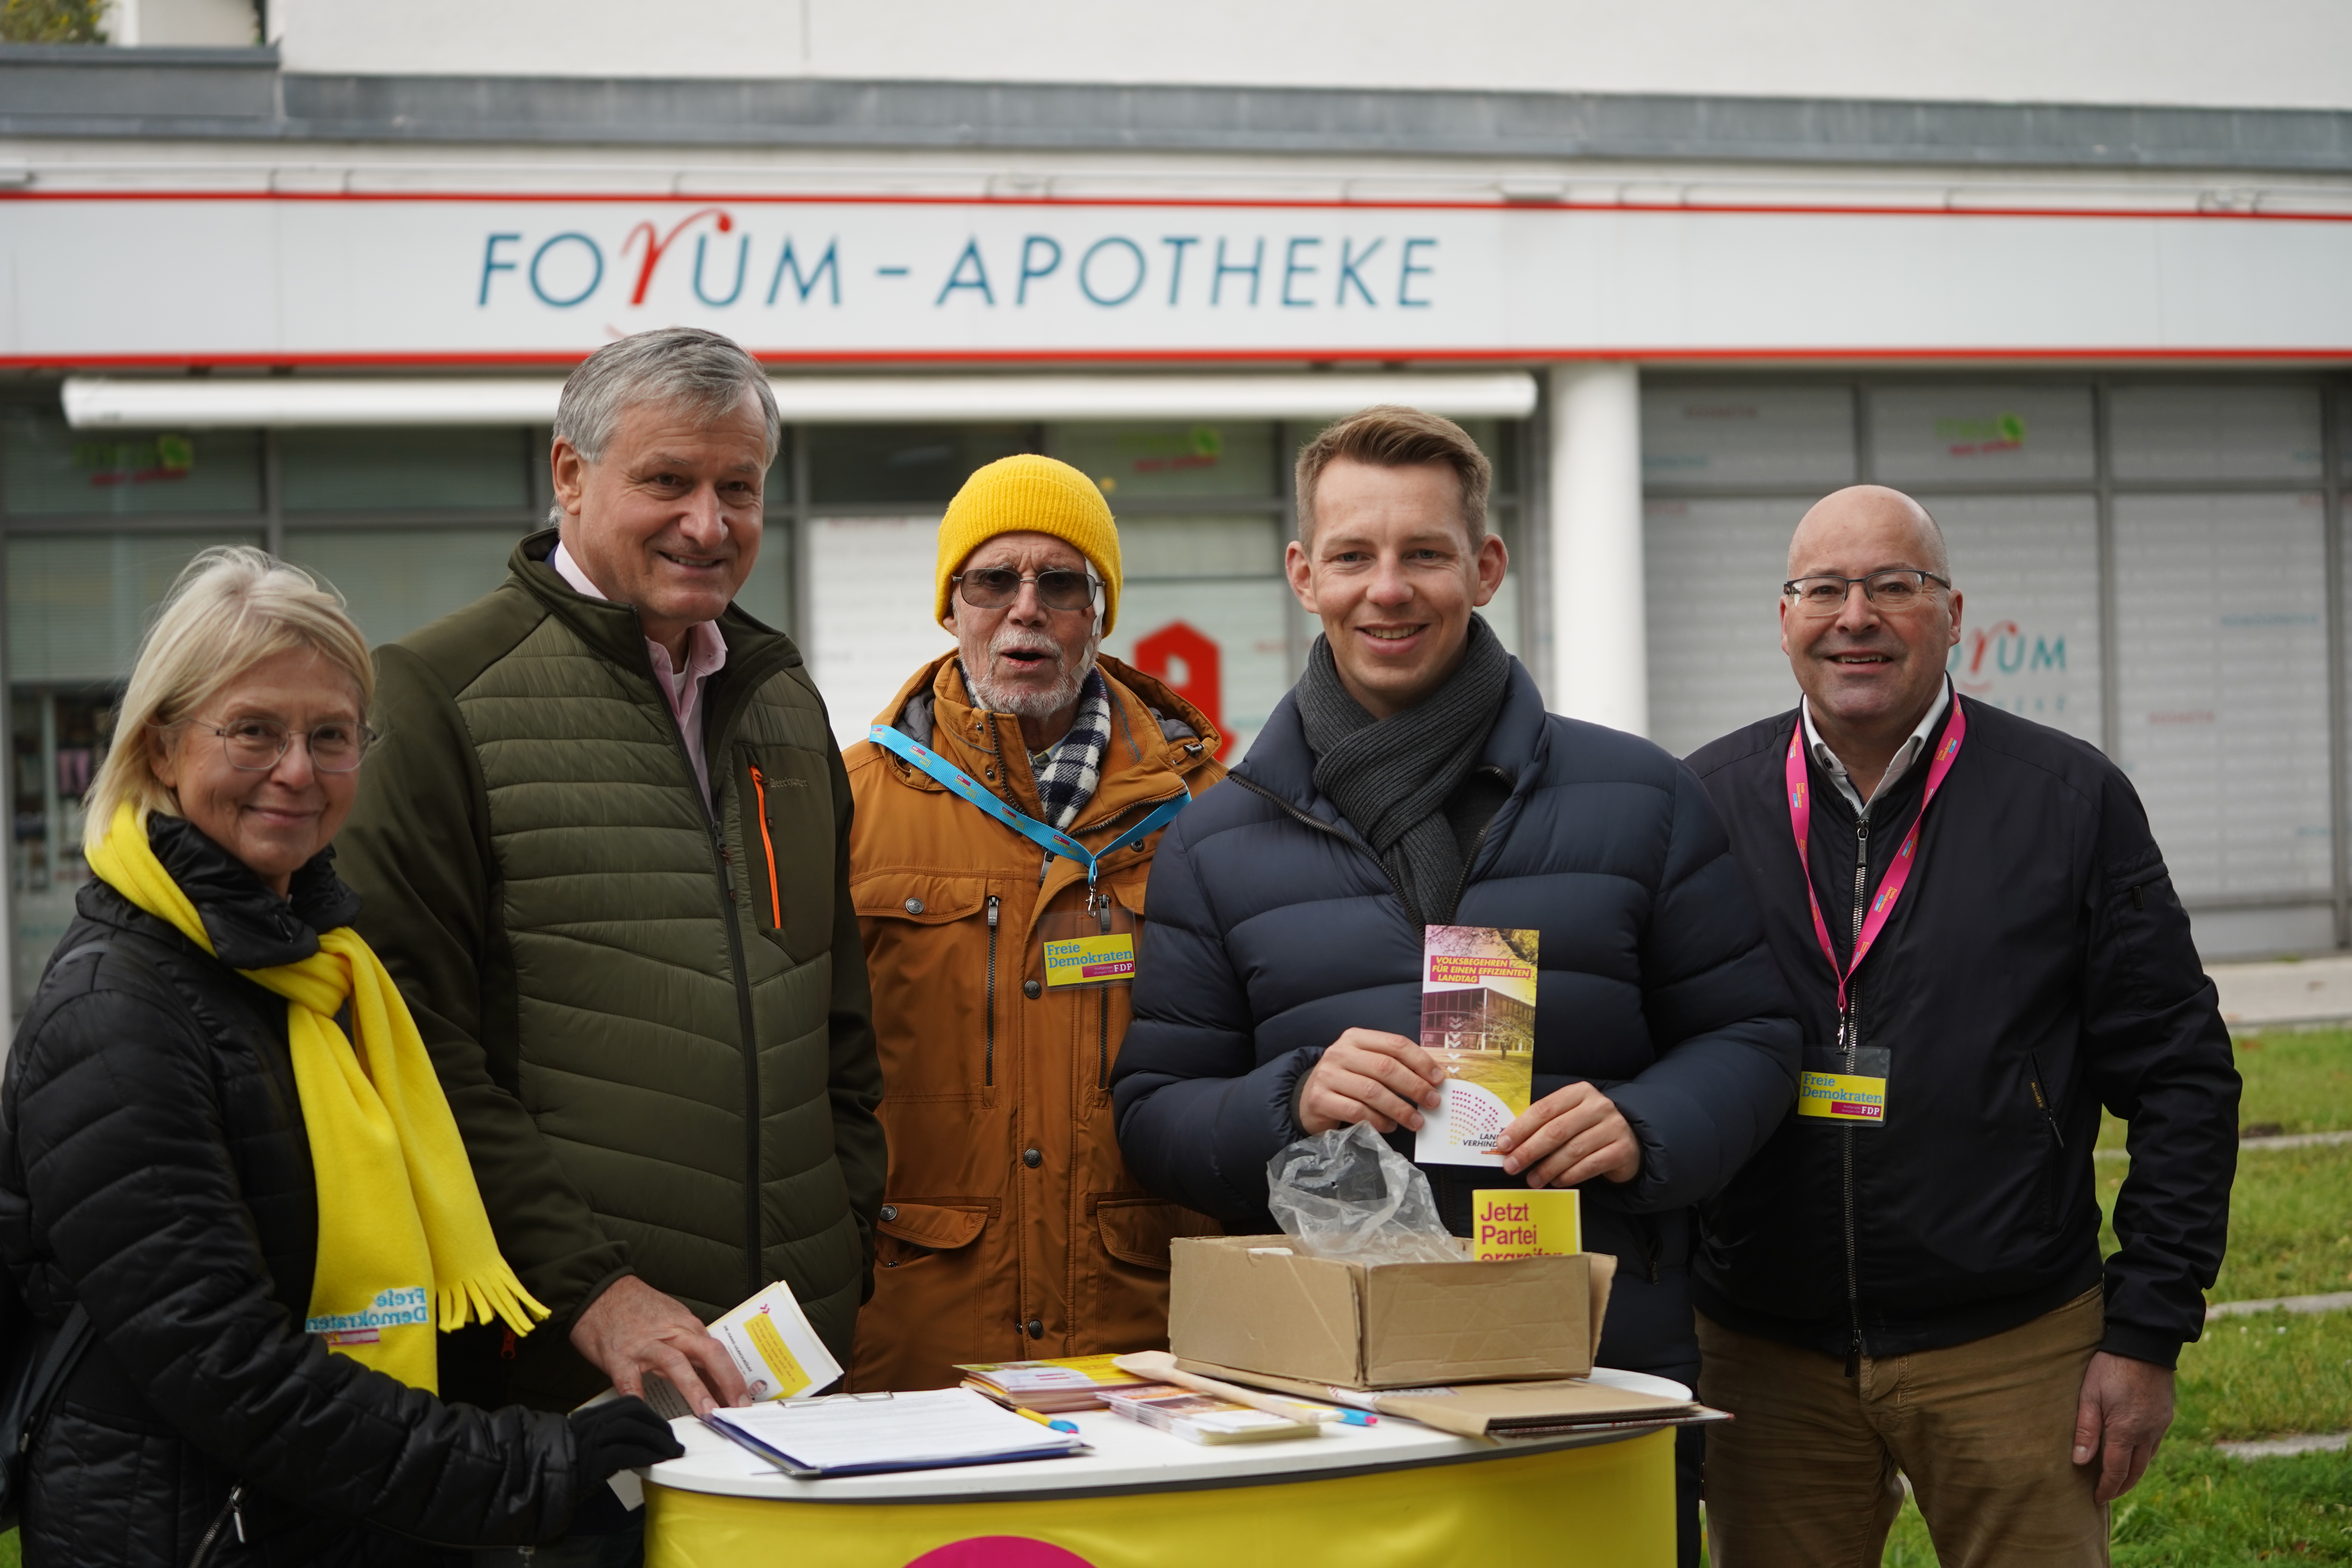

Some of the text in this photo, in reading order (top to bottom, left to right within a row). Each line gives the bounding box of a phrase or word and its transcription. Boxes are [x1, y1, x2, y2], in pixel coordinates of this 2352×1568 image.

[934, 235, 1439, 308] APOTHEKE
[1940, 737, 1954, 760] Demokraten
[1878, 886, 1894, 912] Demokraten
[1889, 888, 1898, 899] Freie
[1046, 942, 1080, 956] Freie
[1048, 950, 1133, 968] Demokraten
[1436, 956, 1508, 967] VOLKSBEGEHREN
[1113, 963, 1132, 972] FDP
[1432, 964, 1448, 973] FÜR
[1478, 967, 1529, 977] EFFIZIENTEN
[1438, 974, 1478, 983] LANDTAG
[1803, 1073, 1835, 1087] Freie
[1802, 1085, 1882, 1103] Demokraten
[1861, 1106, 1880, 1115] FDP
[1481, 1201, 1529, 1221] Jetzt
[1482, 1225, 1537, 1245] Partei
